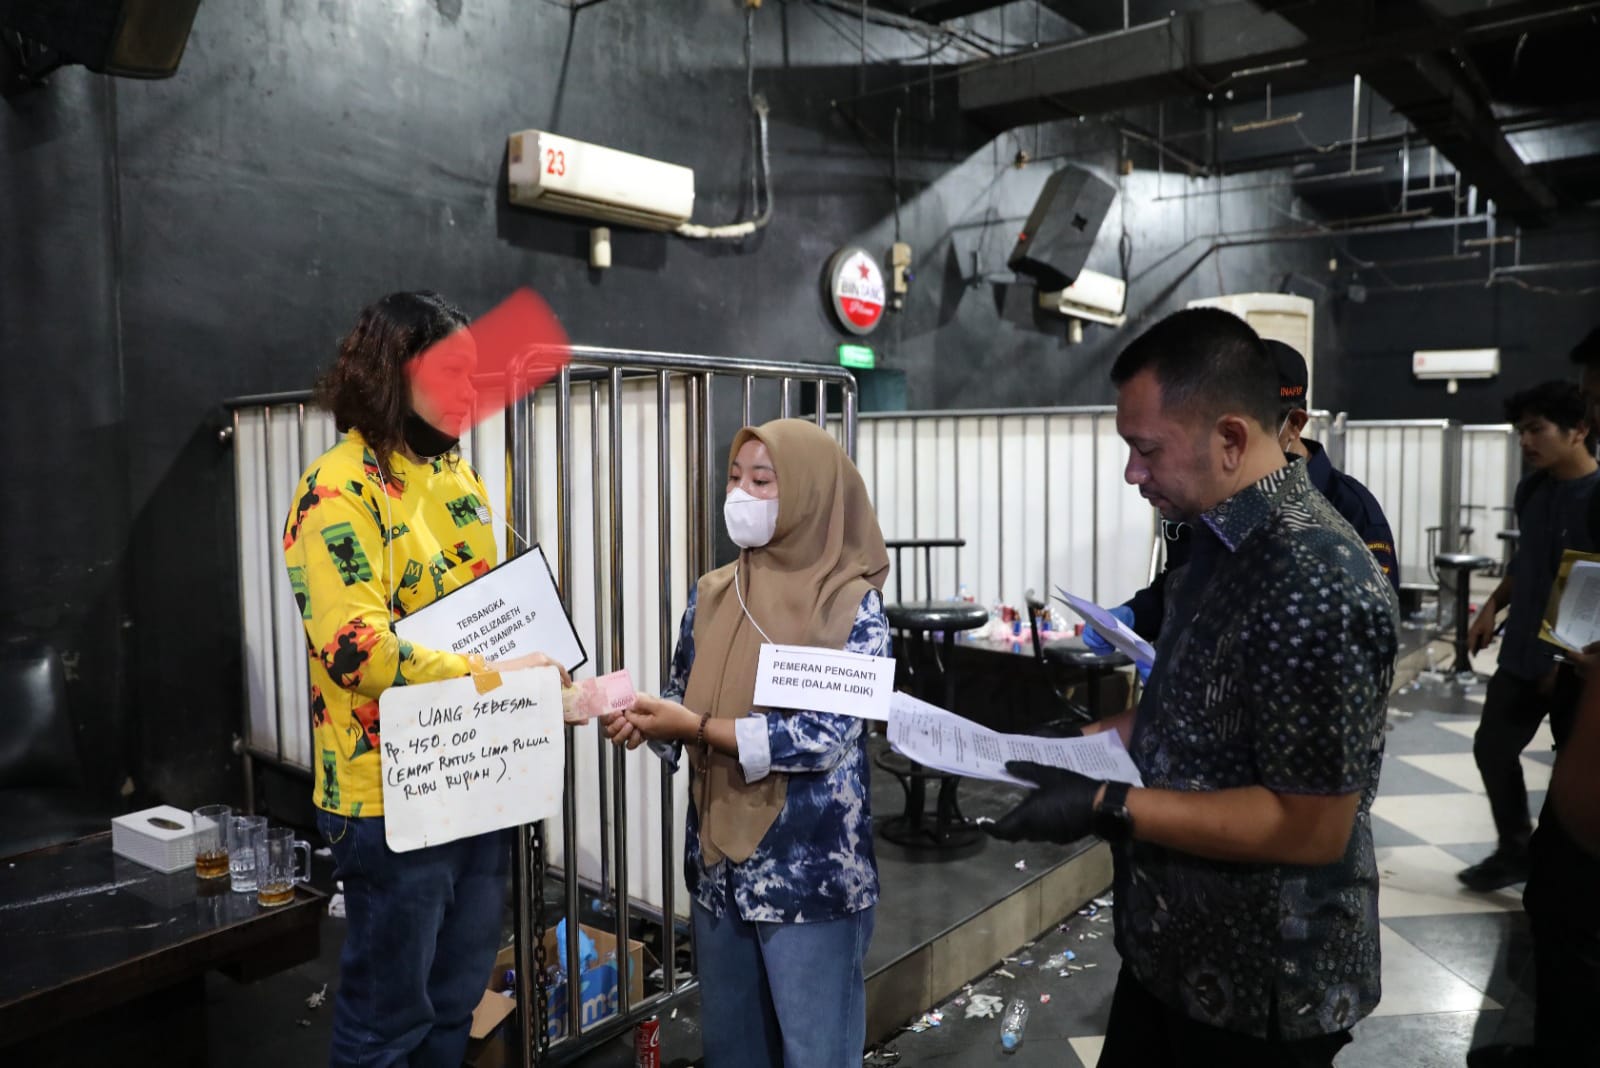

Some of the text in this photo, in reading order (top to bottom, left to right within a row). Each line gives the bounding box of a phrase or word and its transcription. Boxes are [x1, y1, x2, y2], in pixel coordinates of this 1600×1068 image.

[546, 149, 565, 176] 23
[456, 598, 506, 631] TERSANGKA
[451, 606, 521, 652] RENTA ELIZABETH
[499, 639, 516, 656] ELIS
[772, 661, 877, 681] PEMERAN PENGANTI
[771, 676, 874, 698] RERE (DALAM LIDIK)
[418, 697, 538, 728] UANG SEBESAR
[439, 752, 476, 771] RATUS
[481, 744, 509, 759] LIMA
[403, 781, 437, 800] RIBU
